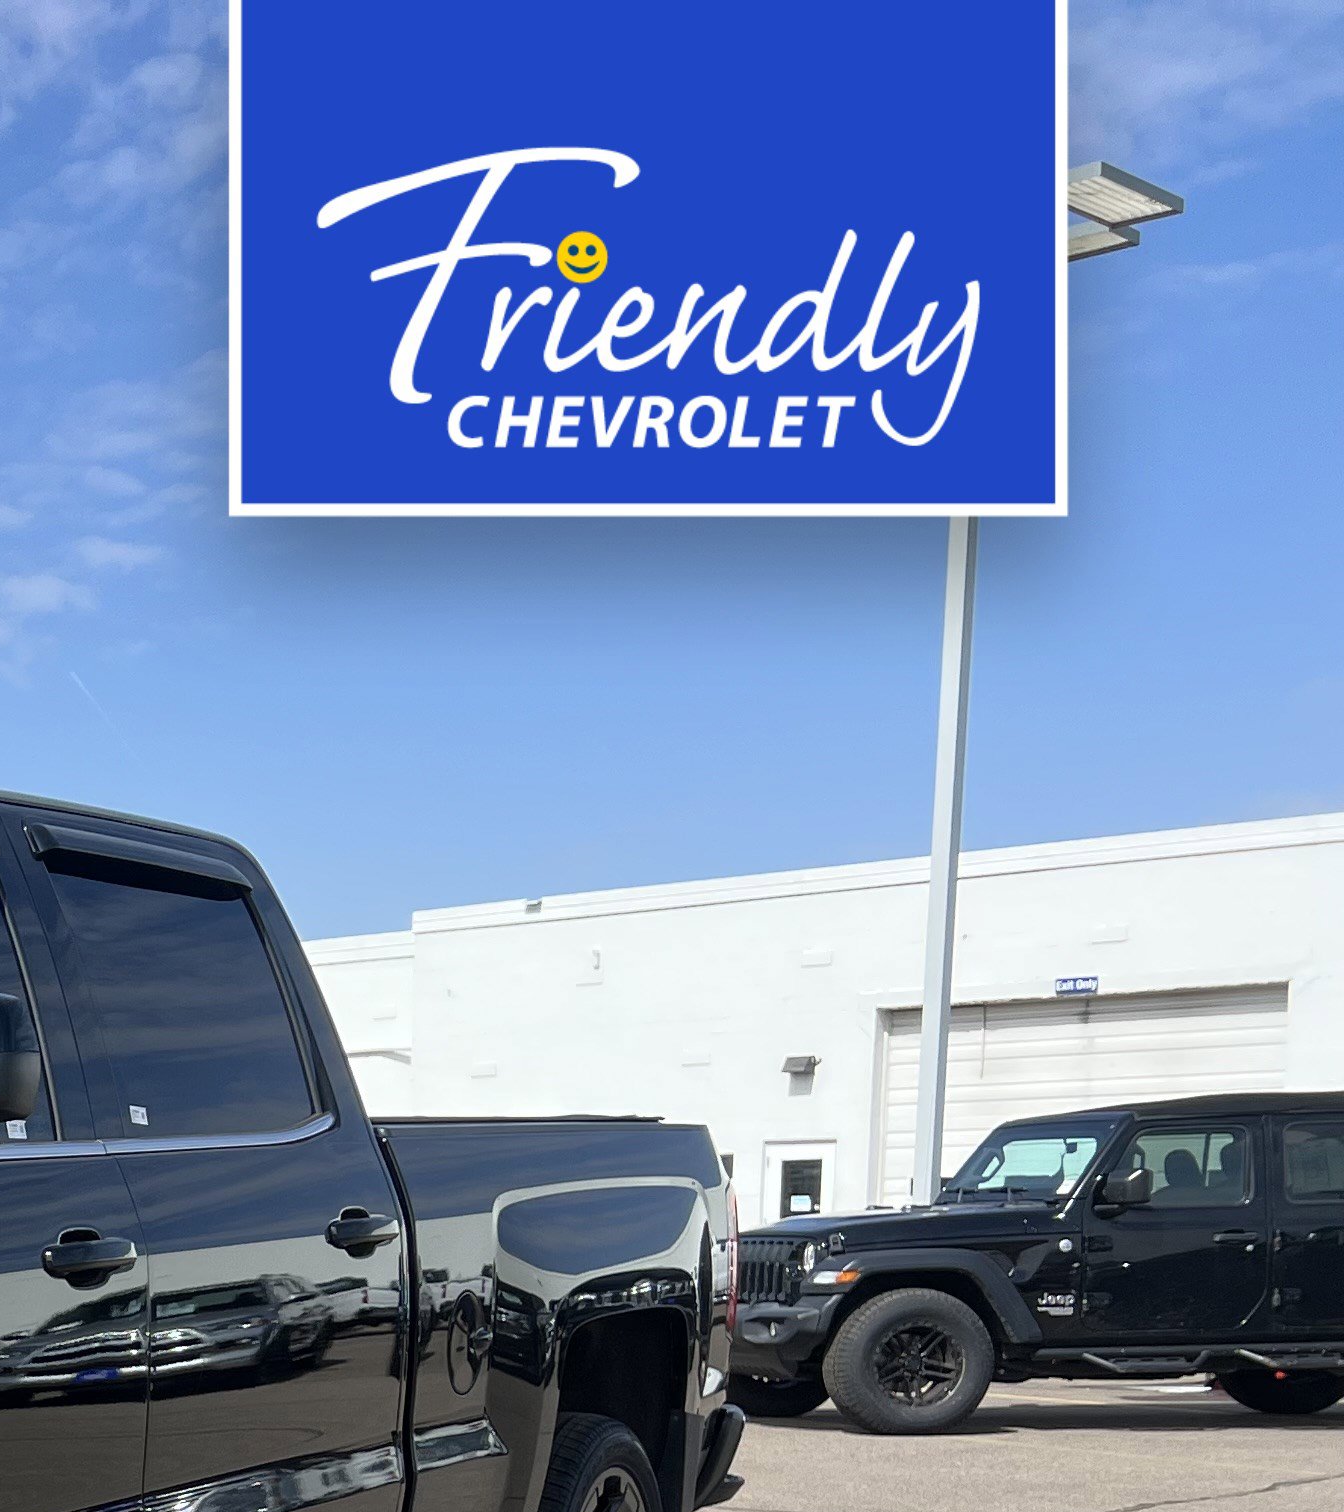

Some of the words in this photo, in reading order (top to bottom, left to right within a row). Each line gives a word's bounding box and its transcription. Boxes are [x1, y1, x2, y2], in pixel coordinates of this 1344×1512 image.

[1056, 980, 1073, 991] Exit
[1075, 978, 1097, 991] Only
[1037, 1291, 1075, 1306] Jeep
